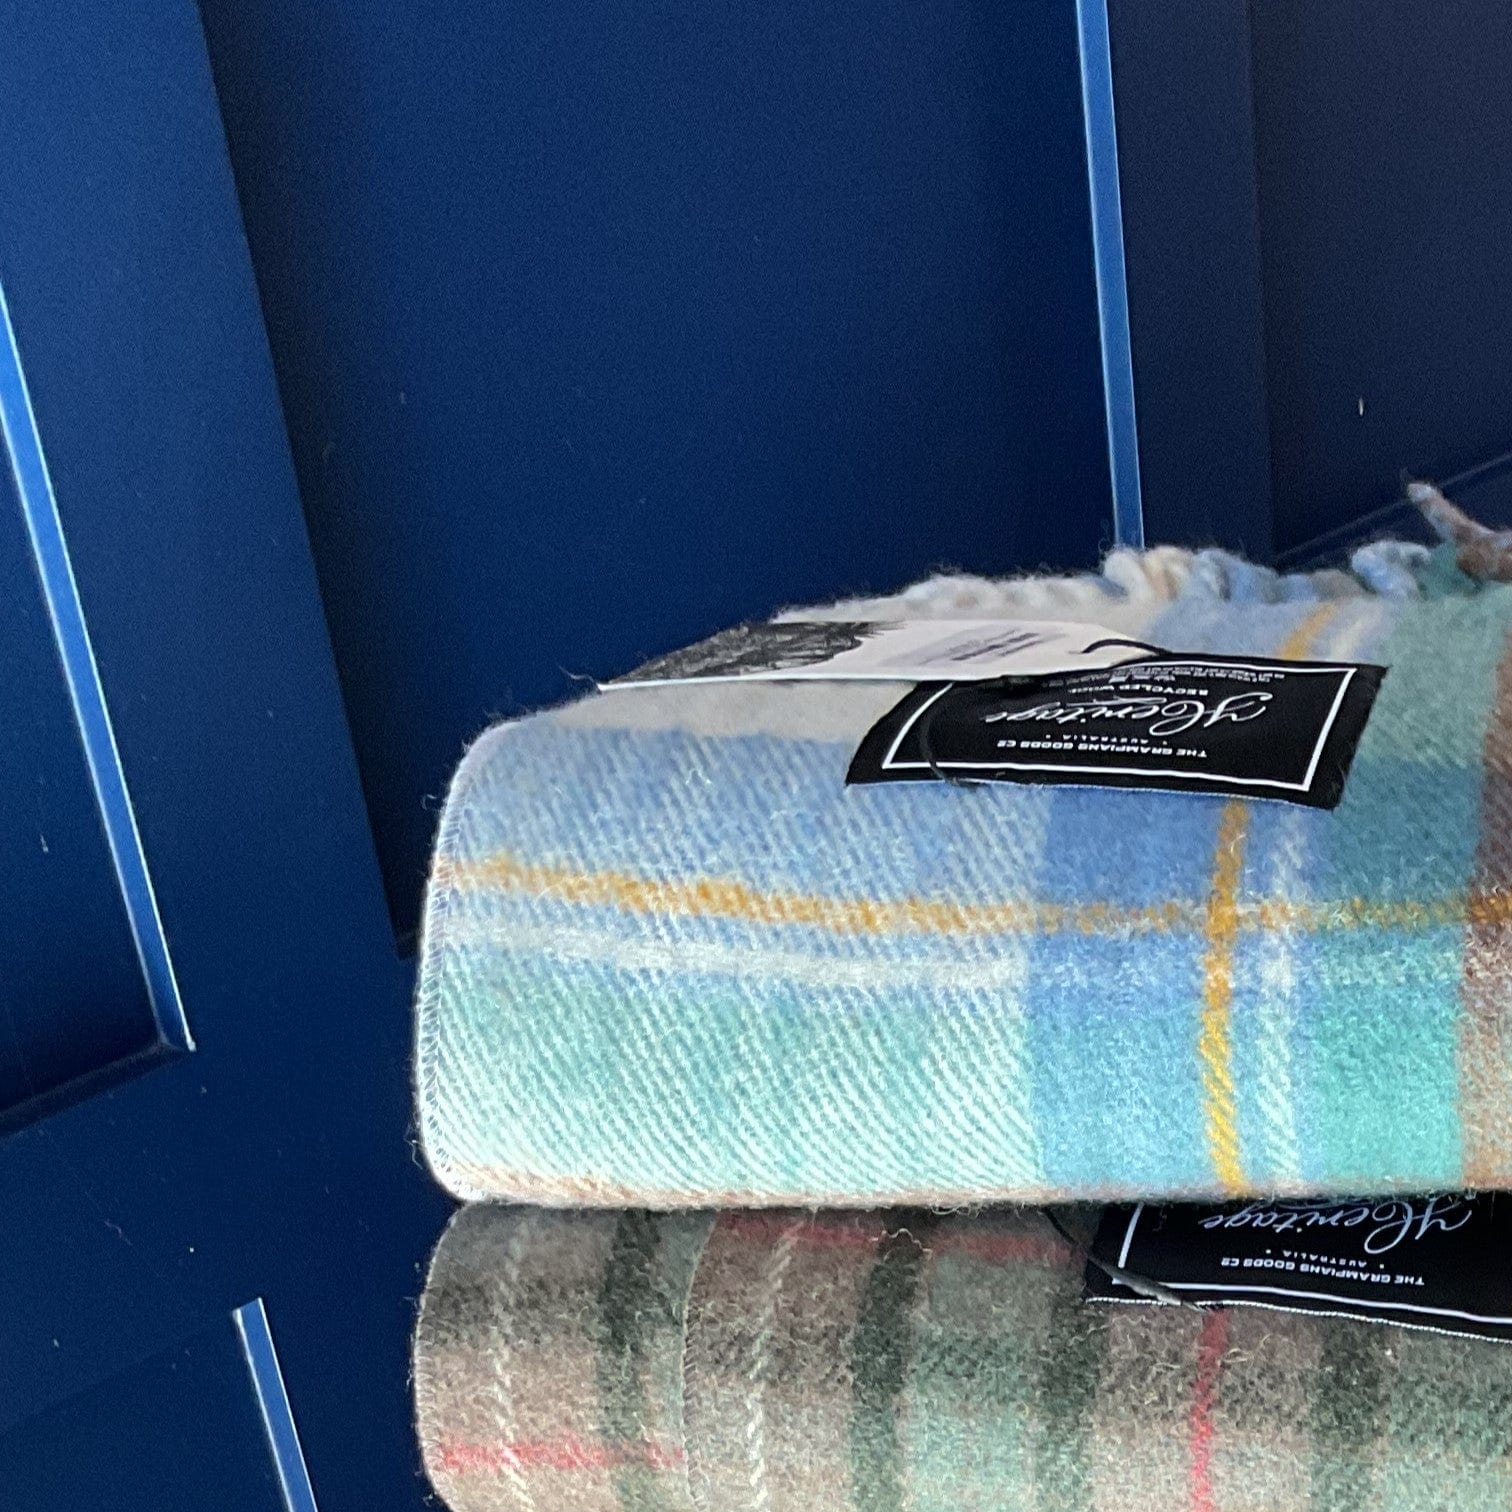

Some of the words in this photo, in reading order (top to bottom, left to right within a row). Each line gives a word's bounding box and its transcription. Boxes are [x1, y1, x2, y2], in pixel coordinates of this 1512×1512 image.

[1119, 684, 1209, 696] RECYCLED
[985, 692, 1274, 736] Heritage
[1020, 740, 1074, 750] GOODS
[1062, 734, 1149, 744] AUSTRALIA
[1078, 741, 1173, 756] GRAMPIANS
[1176, 748, 1208, 758] THE
[1198, 1199, 1473, 1255] Heritage
[1243, 1257, 1295, 1271] GOODS
[1282, 1249, 1367, 1269] AUSTRALIA
[1299, 1262, 1392, 1284] GRAMPIANS
[1394, 1274, 1425, 1286] THE
